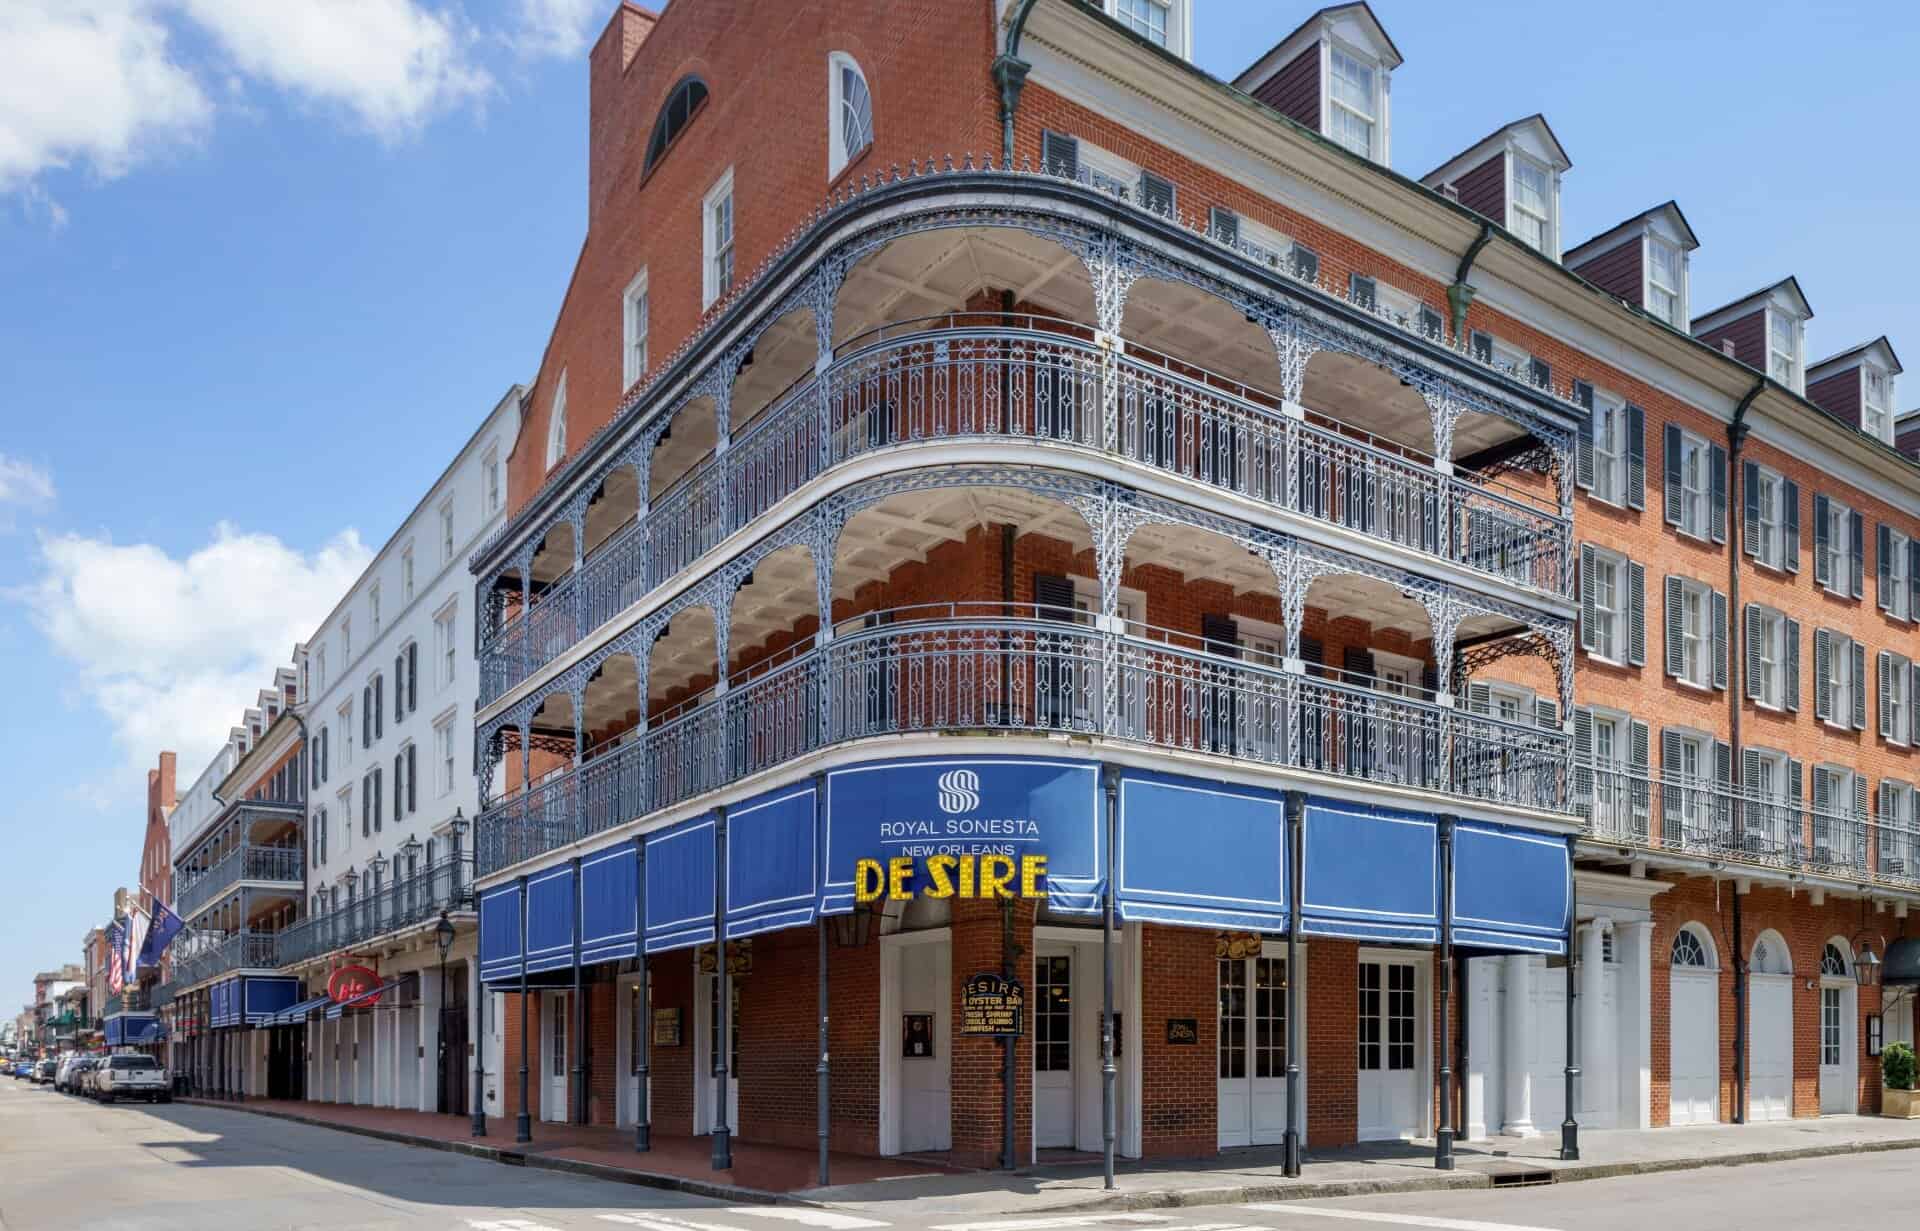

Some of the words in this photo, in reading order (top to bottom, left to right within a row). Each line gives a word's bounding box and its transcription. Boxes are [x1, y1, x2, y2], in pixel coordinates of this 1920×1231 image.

[880, 822, 941, 837] ROYAL
[946, 820, 1039, 835] SONESTA
[902, 845, 935, 857] NEW
[938, 844, 1015, 856] ORLEANS
[855, 854, 1049, 903] DESIRE
